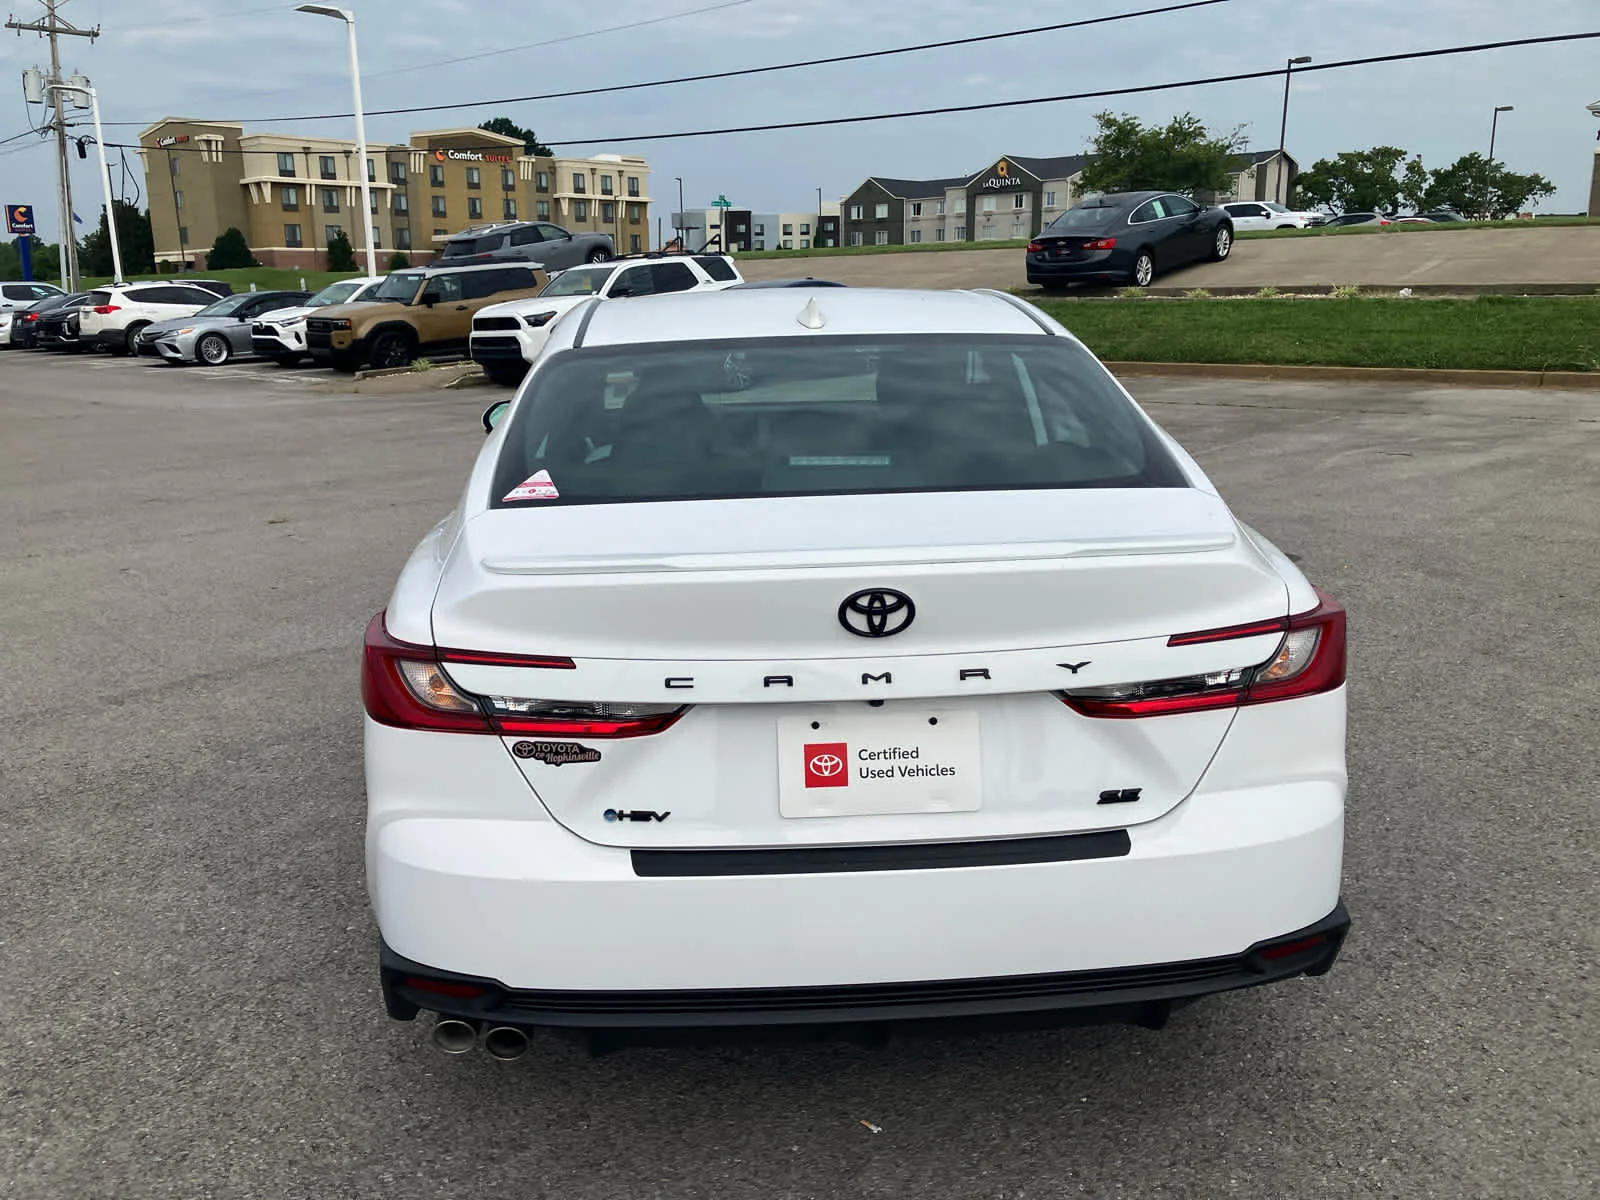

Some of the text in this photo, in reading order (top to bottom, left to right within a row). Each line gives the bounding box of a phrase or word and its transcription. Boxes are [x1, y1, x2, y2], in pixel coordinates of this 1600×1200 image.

[448, 150, 482, 161] Comfort
[664, 661, 1092, 689] CAMRY
[535, 743, 580, 753] TOYOTA
[858, 746, 919, 761] Certified
[546, 751, 599, 765] Hopkinsville
[859, 764, 956, 779] Used Vehicles
[1096, 788, 1142, 804] SE
[617, 810, 671, 822] HEV
